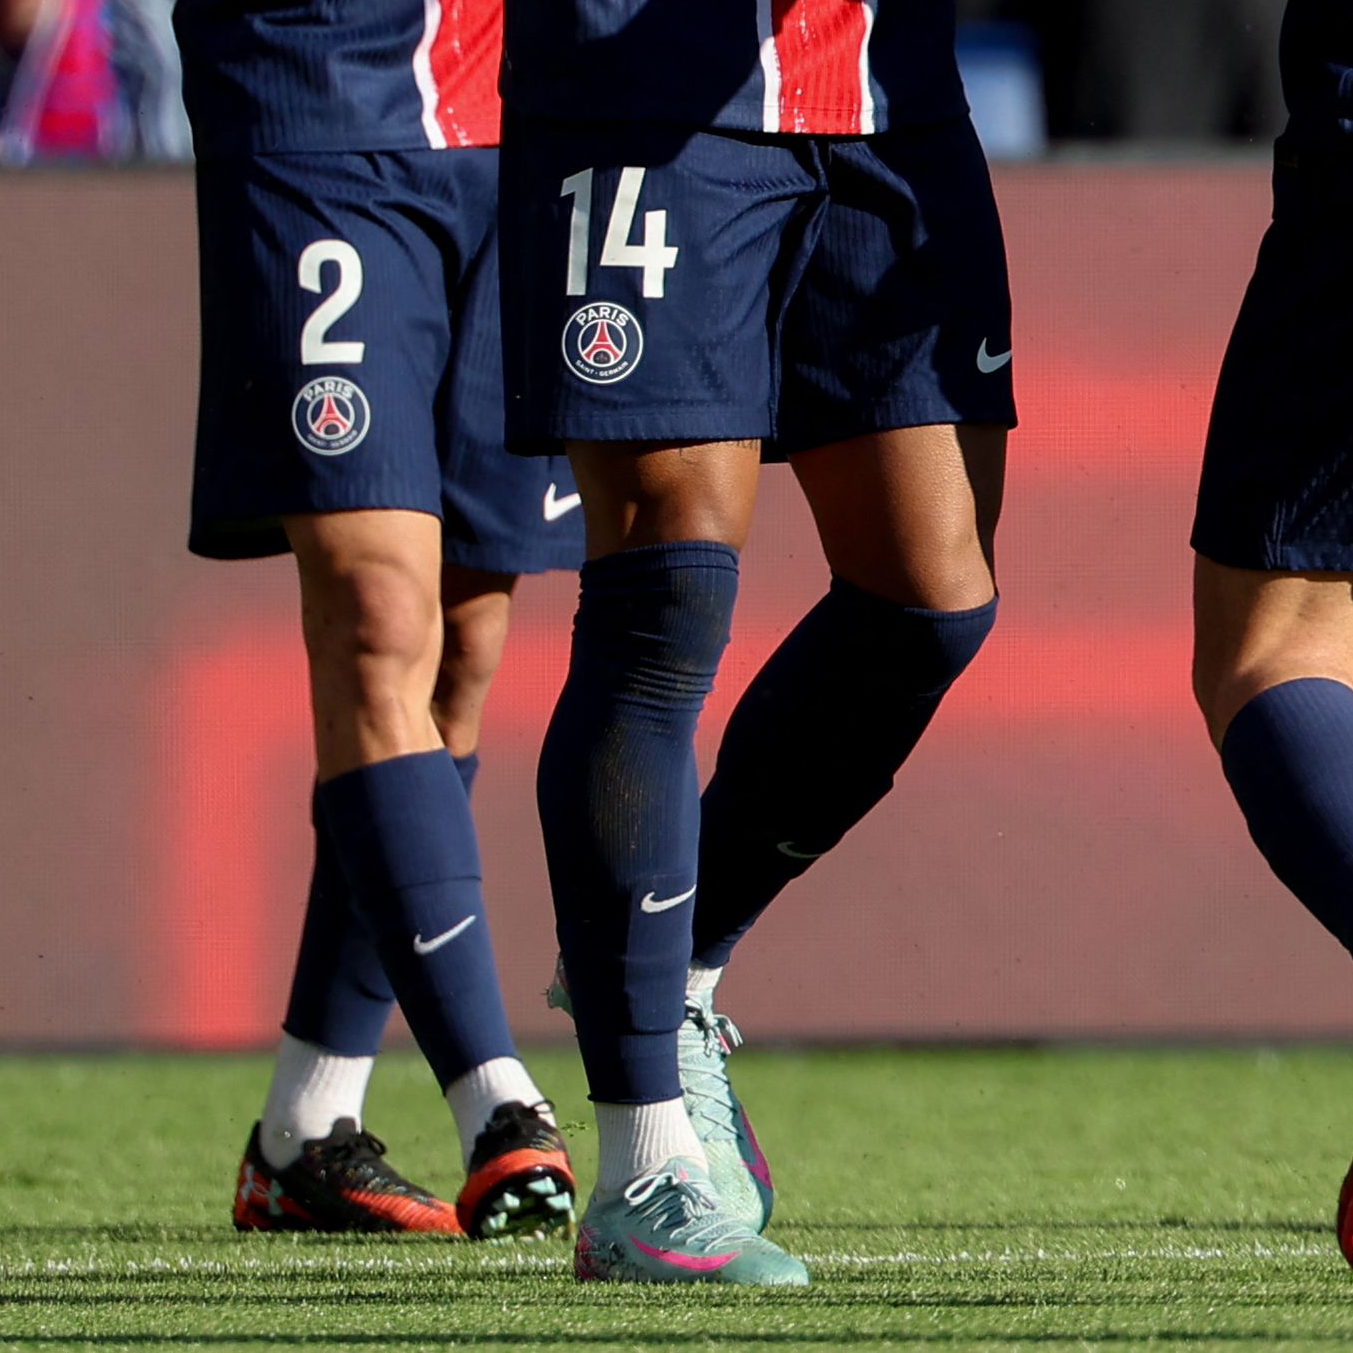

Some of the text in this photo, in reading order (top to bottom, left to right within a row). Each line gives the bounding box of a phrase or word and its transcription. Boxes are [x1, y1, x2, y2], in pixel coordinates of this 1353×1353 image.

[560, 166, 679, 299] 14
[298, 239, 365, 365] 2
[575, 307, 629, 327] PARIS
[302, 381, 355, 403] PARIS
